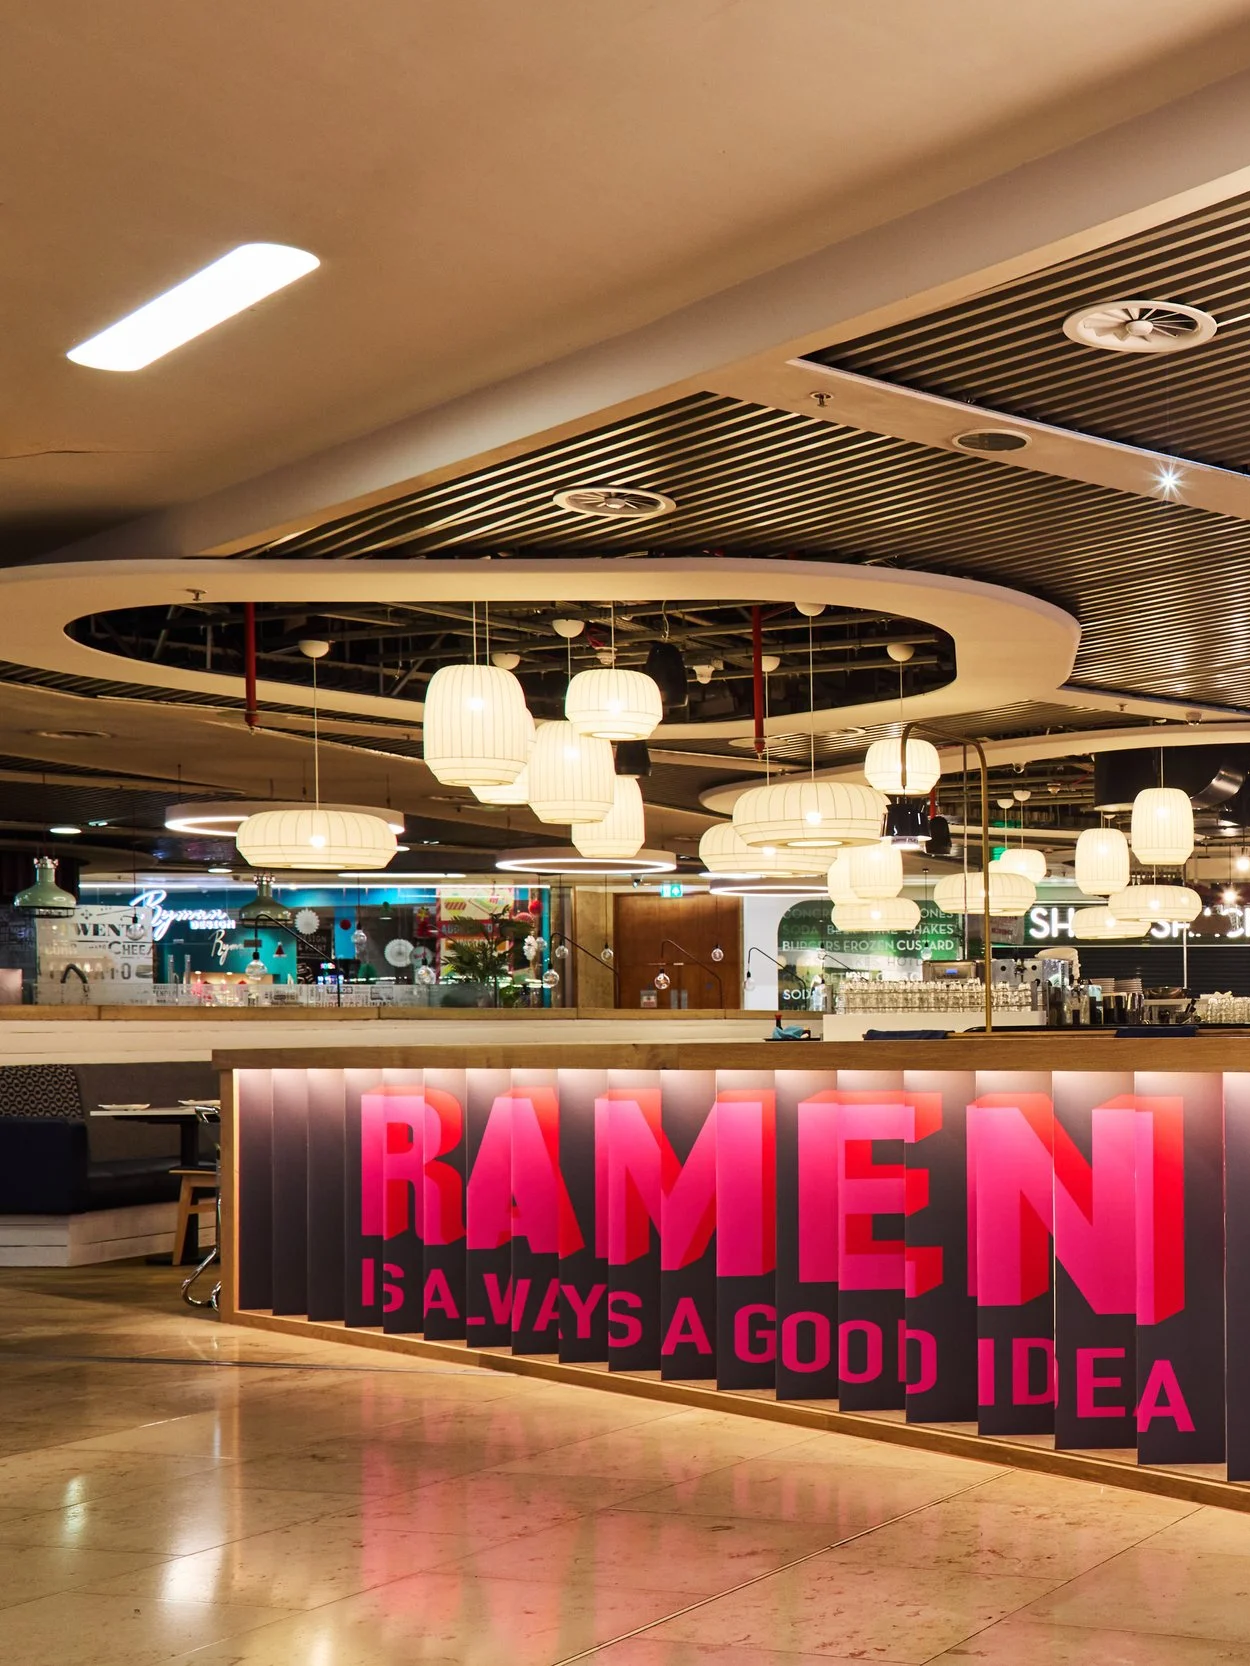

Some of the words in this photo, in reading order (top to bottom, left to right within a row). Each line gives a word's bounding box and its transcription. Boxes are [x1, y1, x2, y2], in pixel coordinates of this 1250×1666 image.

[129, 889, 227, 941] Ryman
[919, 908, 954, 919] ONES
[189, 919, 236, 930] DESIGN
[842, 940, 896, 952] FROZEN
[896, 940, 954, 951] CUSTARD
[782, 988, 812, 1000] SOD
[360, 1086, 1186, 1326] RAMEN
[361, 1257, 405, 1314] IS
[661, 1296, 713, 1356] A
[733, 1303, 938, 1395] GOOD
[978, 1336, 1196, 1434] IDEA
